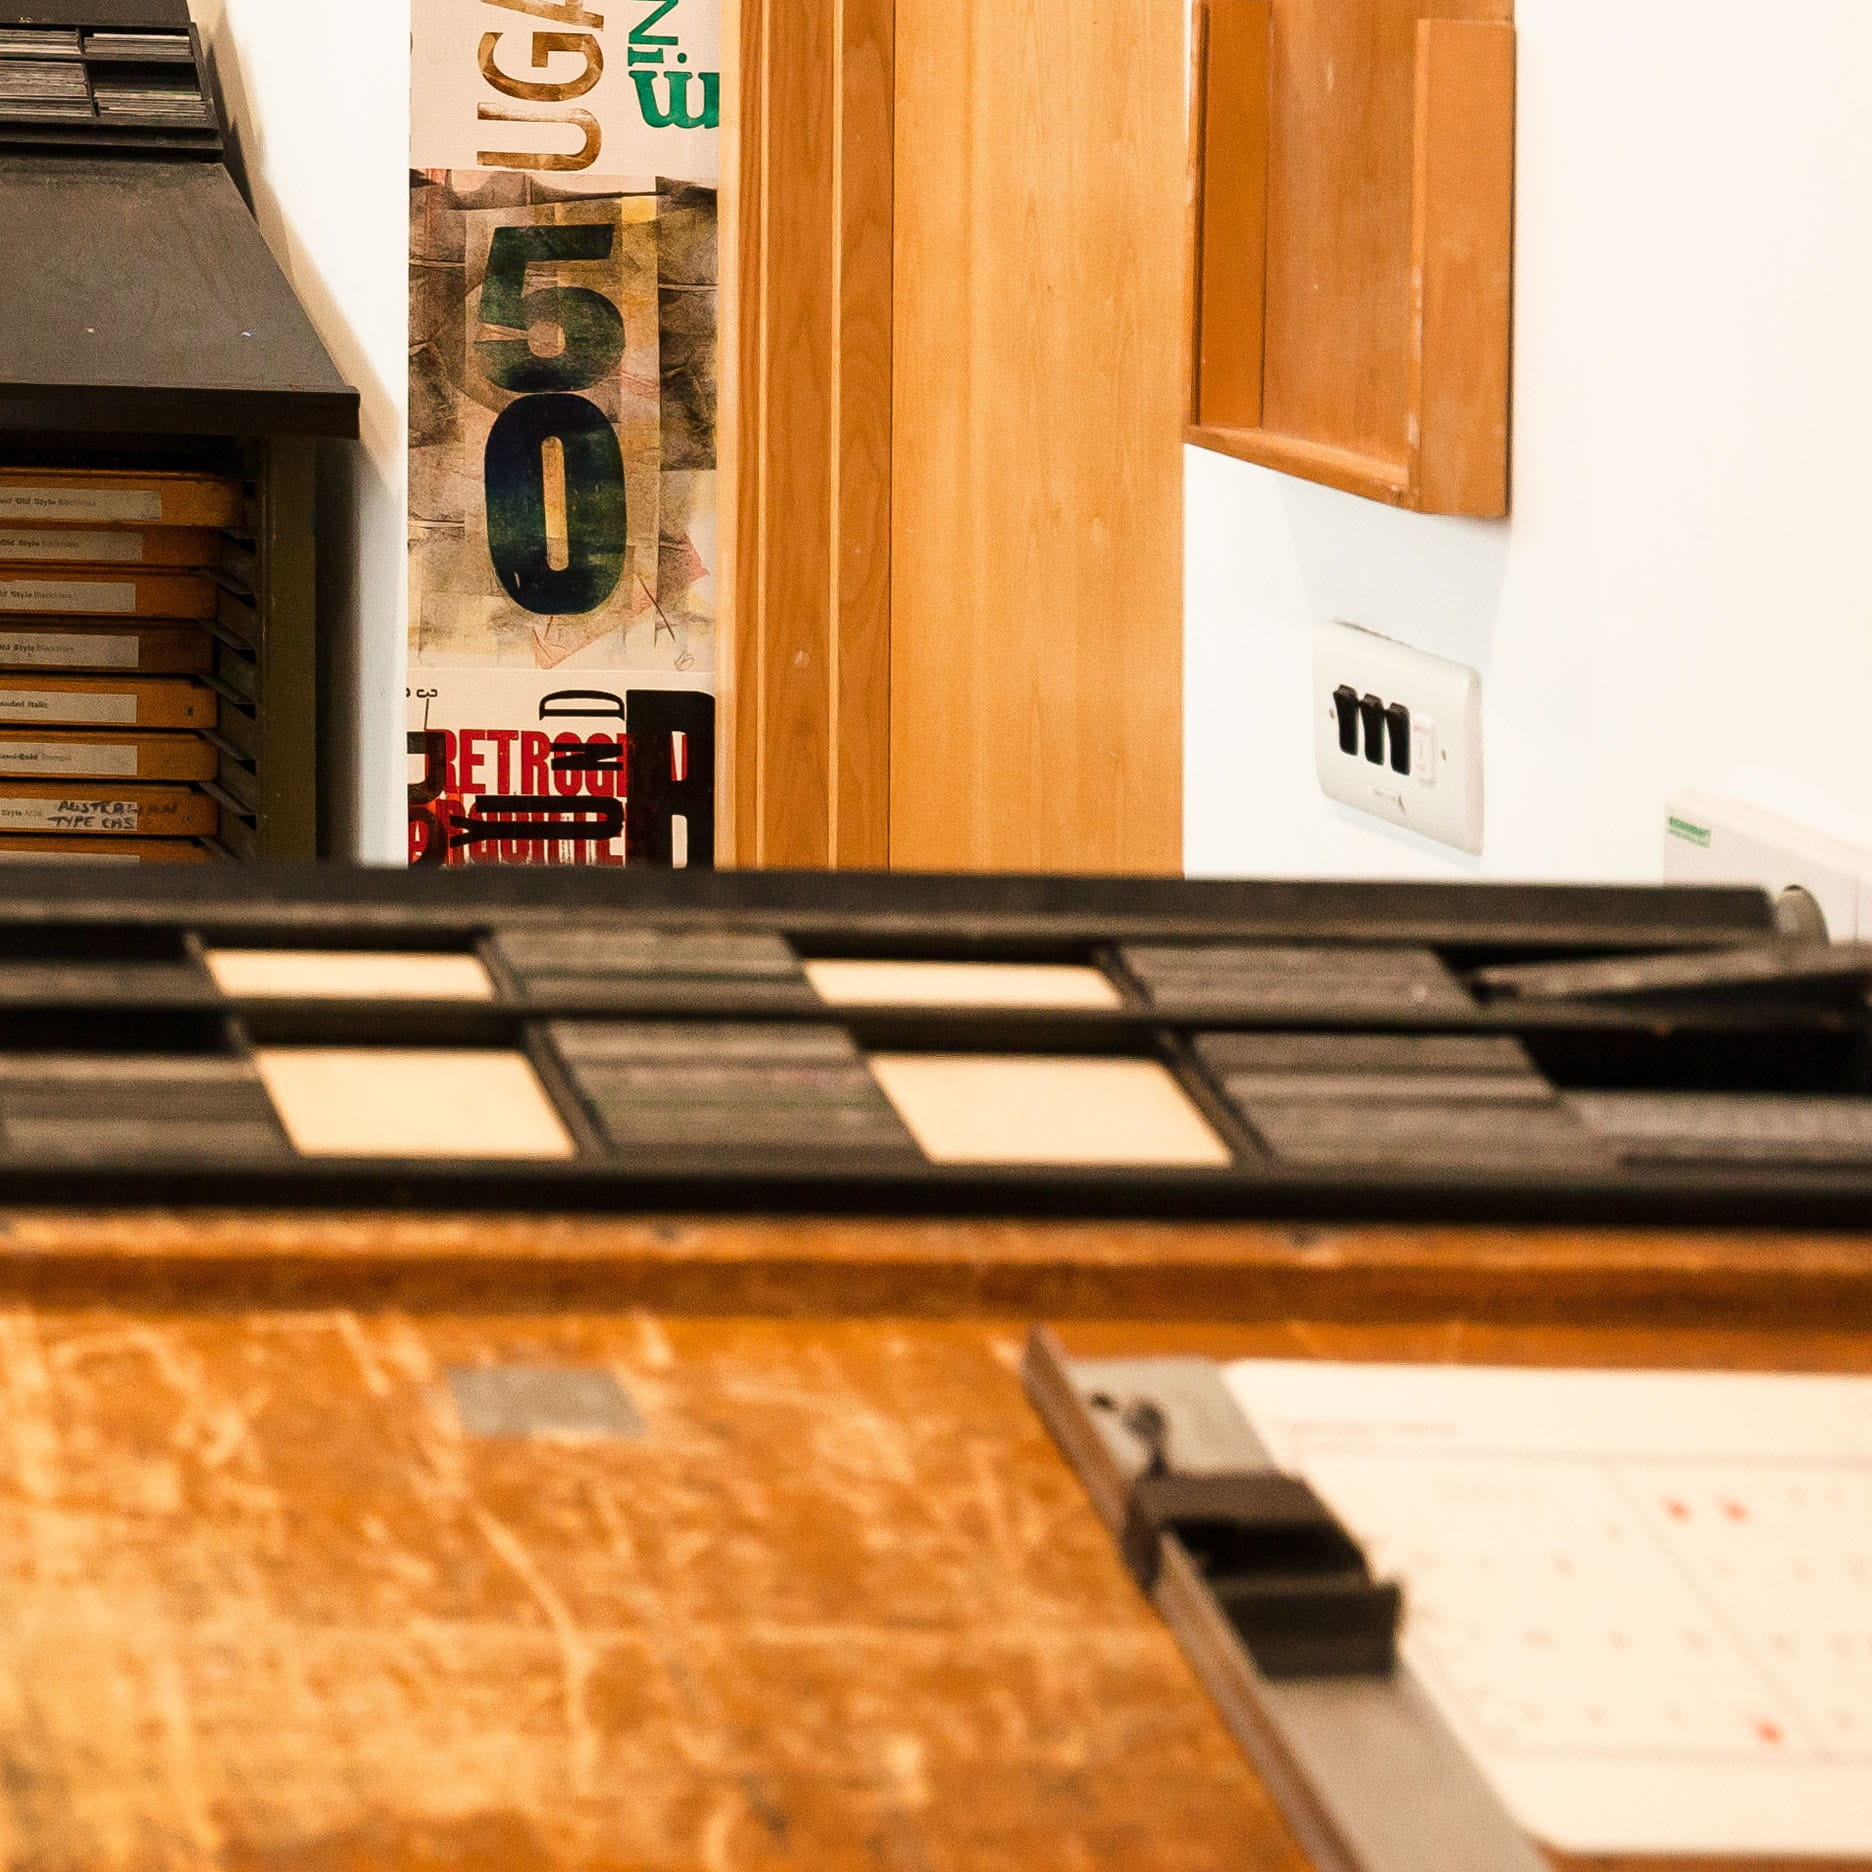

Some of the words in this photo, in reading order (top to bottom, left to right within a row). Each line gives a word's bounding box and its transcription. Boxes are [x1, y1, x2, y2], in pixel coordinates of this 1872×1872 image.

[33, 497, 57, 507] Style
[18, 539, 41, 549] Style
[10, 590, 33, 599] Style
[13, 643, 36, 653] Style
[48, 816, 93, 829] TYPE
